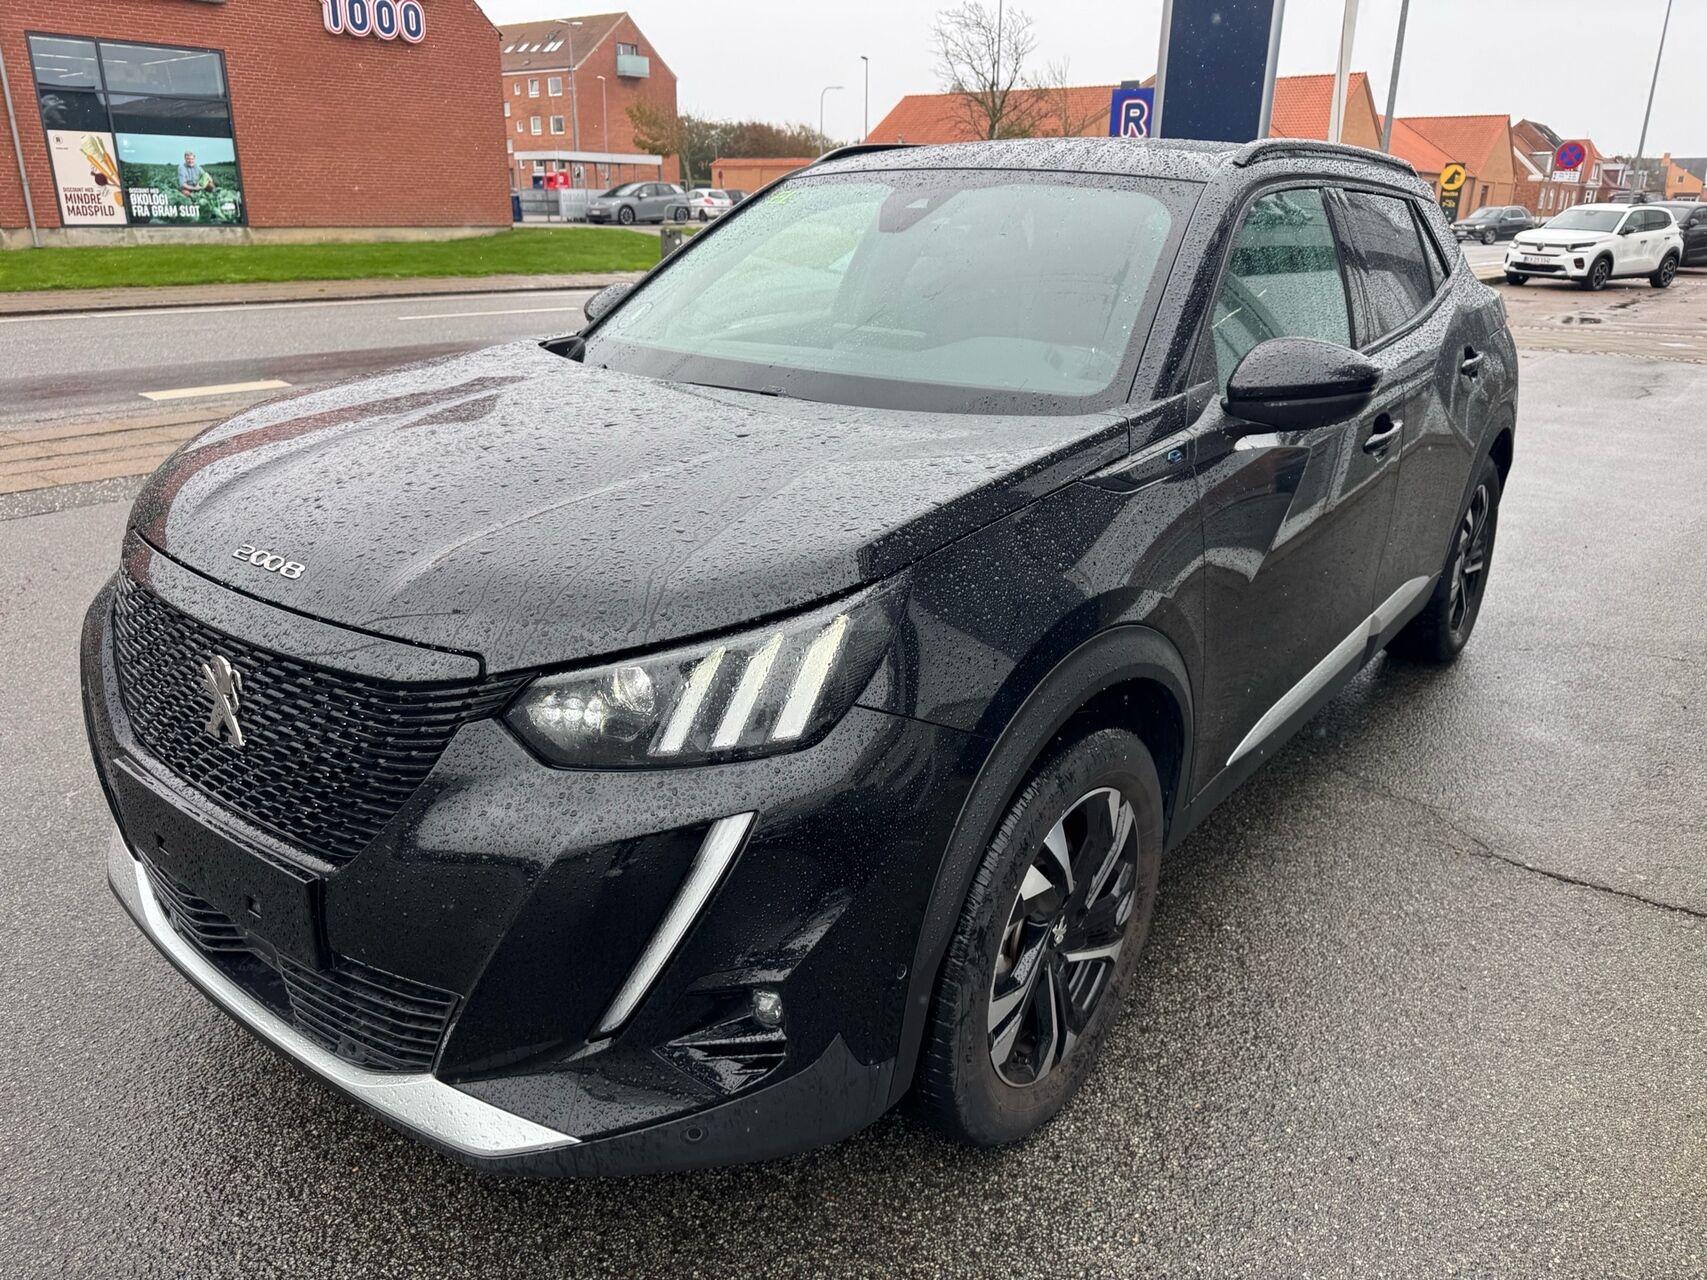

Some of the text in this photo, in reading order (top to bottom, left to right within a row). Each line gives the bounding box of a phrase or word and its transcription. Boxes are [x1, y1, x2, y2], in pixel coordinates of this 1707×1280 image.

[323, 0, 426, 43] 1000
[1121, 100, 1148, 137] R
[65, 193, 102, 204] MINDRE
[130, 193, 168, 205] ØKOLOGI
[67, 205, 115, 217] MADSPILD
[132, 205, 200, 217] FRA GRAM SLOT
[232, 544, 305, 579] 2008
